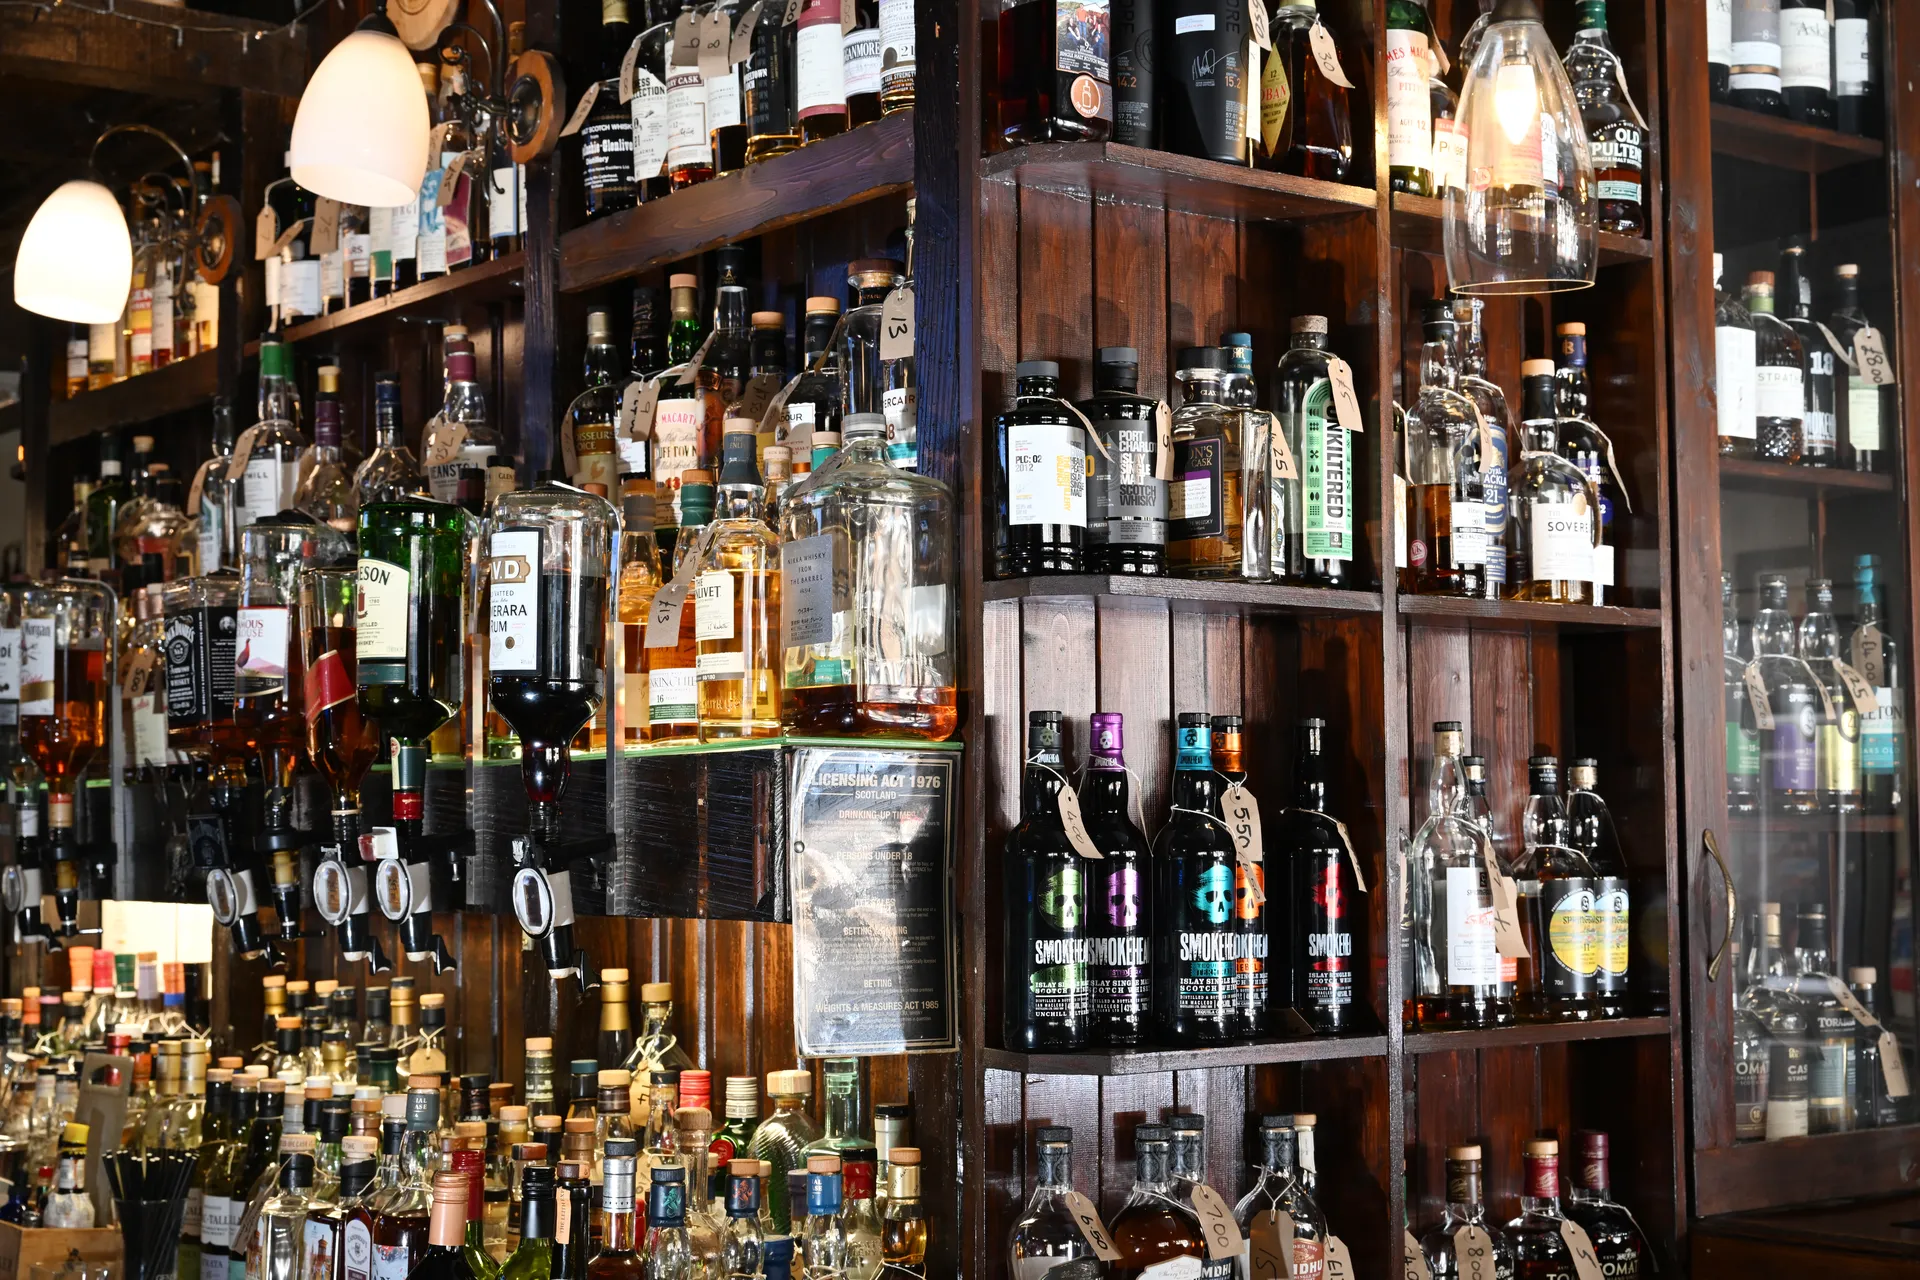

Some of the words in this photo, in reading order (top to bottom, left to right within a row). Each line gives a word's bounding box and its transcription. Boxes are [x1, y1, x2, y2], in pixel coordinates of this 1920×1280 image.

[1614, 127, 1641, 146] OLD
[1809, 351, 1835, 376] 18
[1119, 430, 1144, 442] PORT
[1120, 453, 1146, 464] ISLAY
[1120, 464, 1151, 476] SINGLE
[1120, 475, 1145, 485] MALT
[1120, 485, 1157, 496] SCOTCH
[1120, 495, 1157, 507] WHISKY
[804, 551, 827, 561] WHISKY
[656, 694, 665, 703] 16
[809, 772, 878, 788] LICENSING
[881, 774, 906, 788] ACT
[909, 775, 941, 789] 1976
[855, 790, 897, 800] SCOTLAND
[839, 809, 891, 820] DRINKING-UP
[1232, 806, 1253, 849] 5.50
[836, 851, 873, 861] PERSONS
[875, 851, 902, 861] UNDER
[903, 851, 913, 861] 18
[843, 926, 873, 937] BETTING
[863, 979, 893, 988] BETTING
[815, 1003, 851, 1014] WEIGHTS
[861, 1001, 903, 1012] MEASURES
[904, 1000, 919, 1010] ACT
[921, 1000, 940, 1010] 1985
